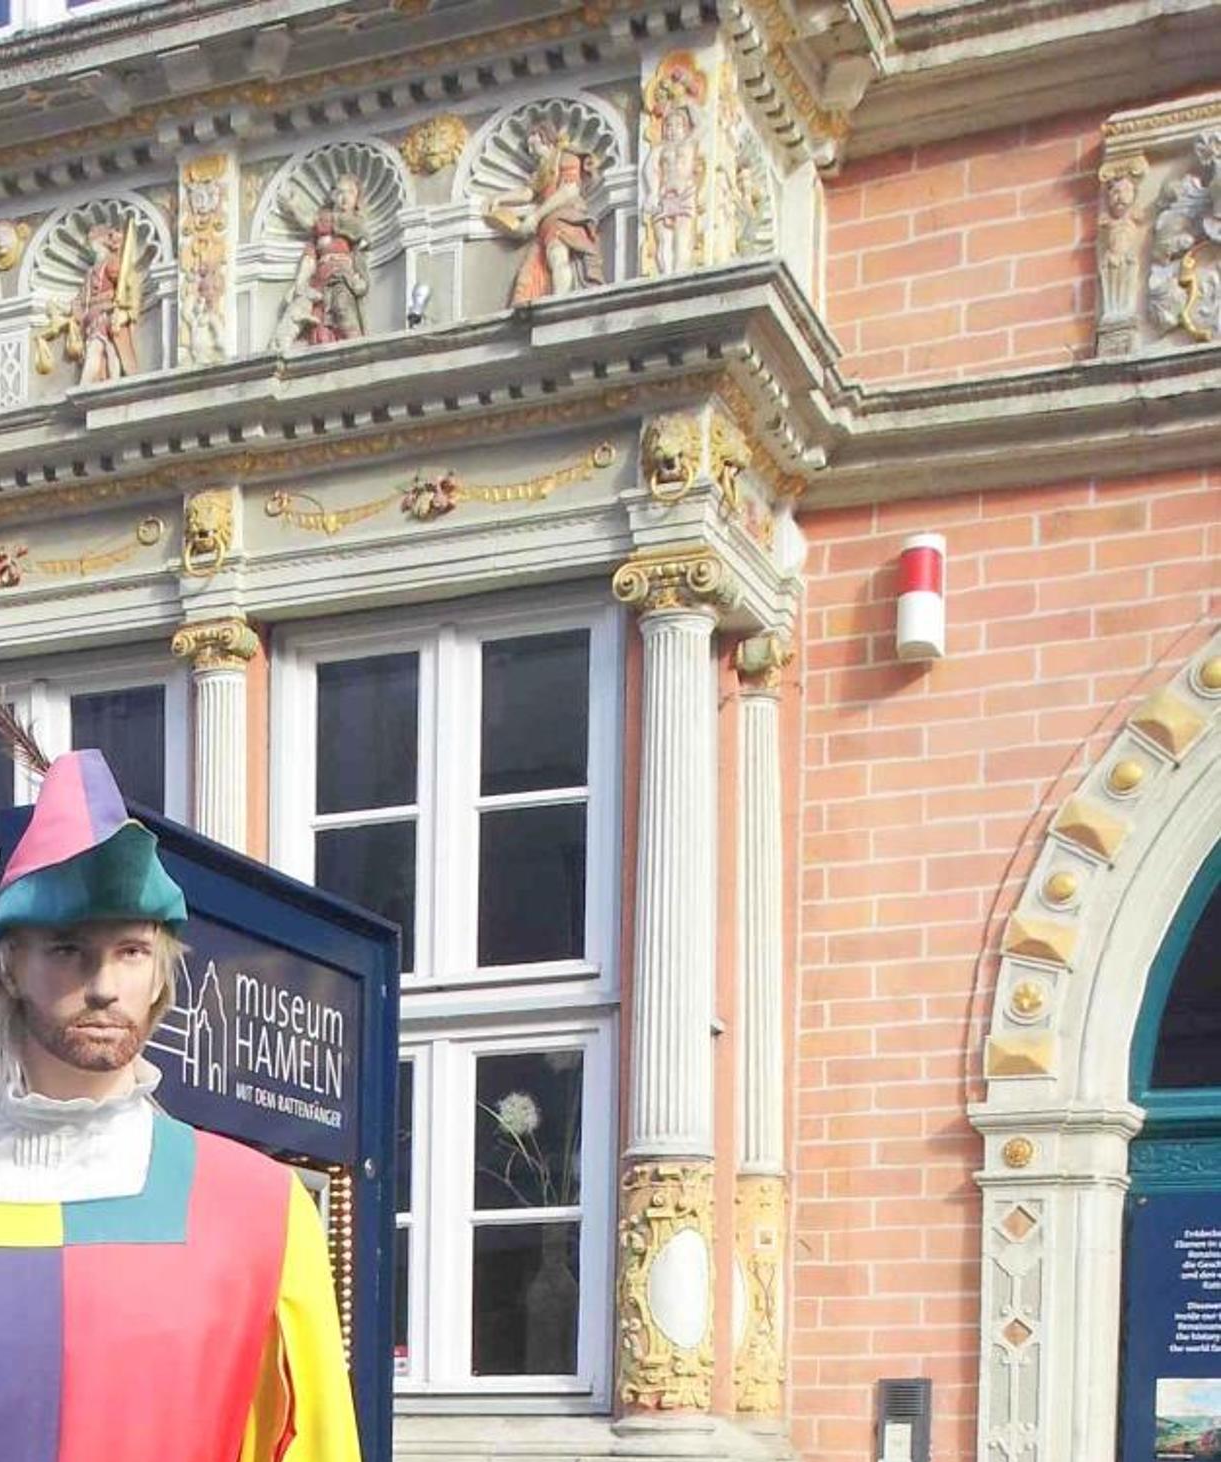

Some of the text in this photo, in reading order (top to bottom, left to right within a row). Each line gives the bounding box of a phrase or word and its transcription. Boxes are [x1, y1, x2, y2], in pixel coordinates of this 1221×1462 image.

[236, 973, 343, 1047] museum
[235, 1016, 343, 1099] HAMELN
[236, 1081, 343, 1129] MIT DEM RATTENFÄNGER
